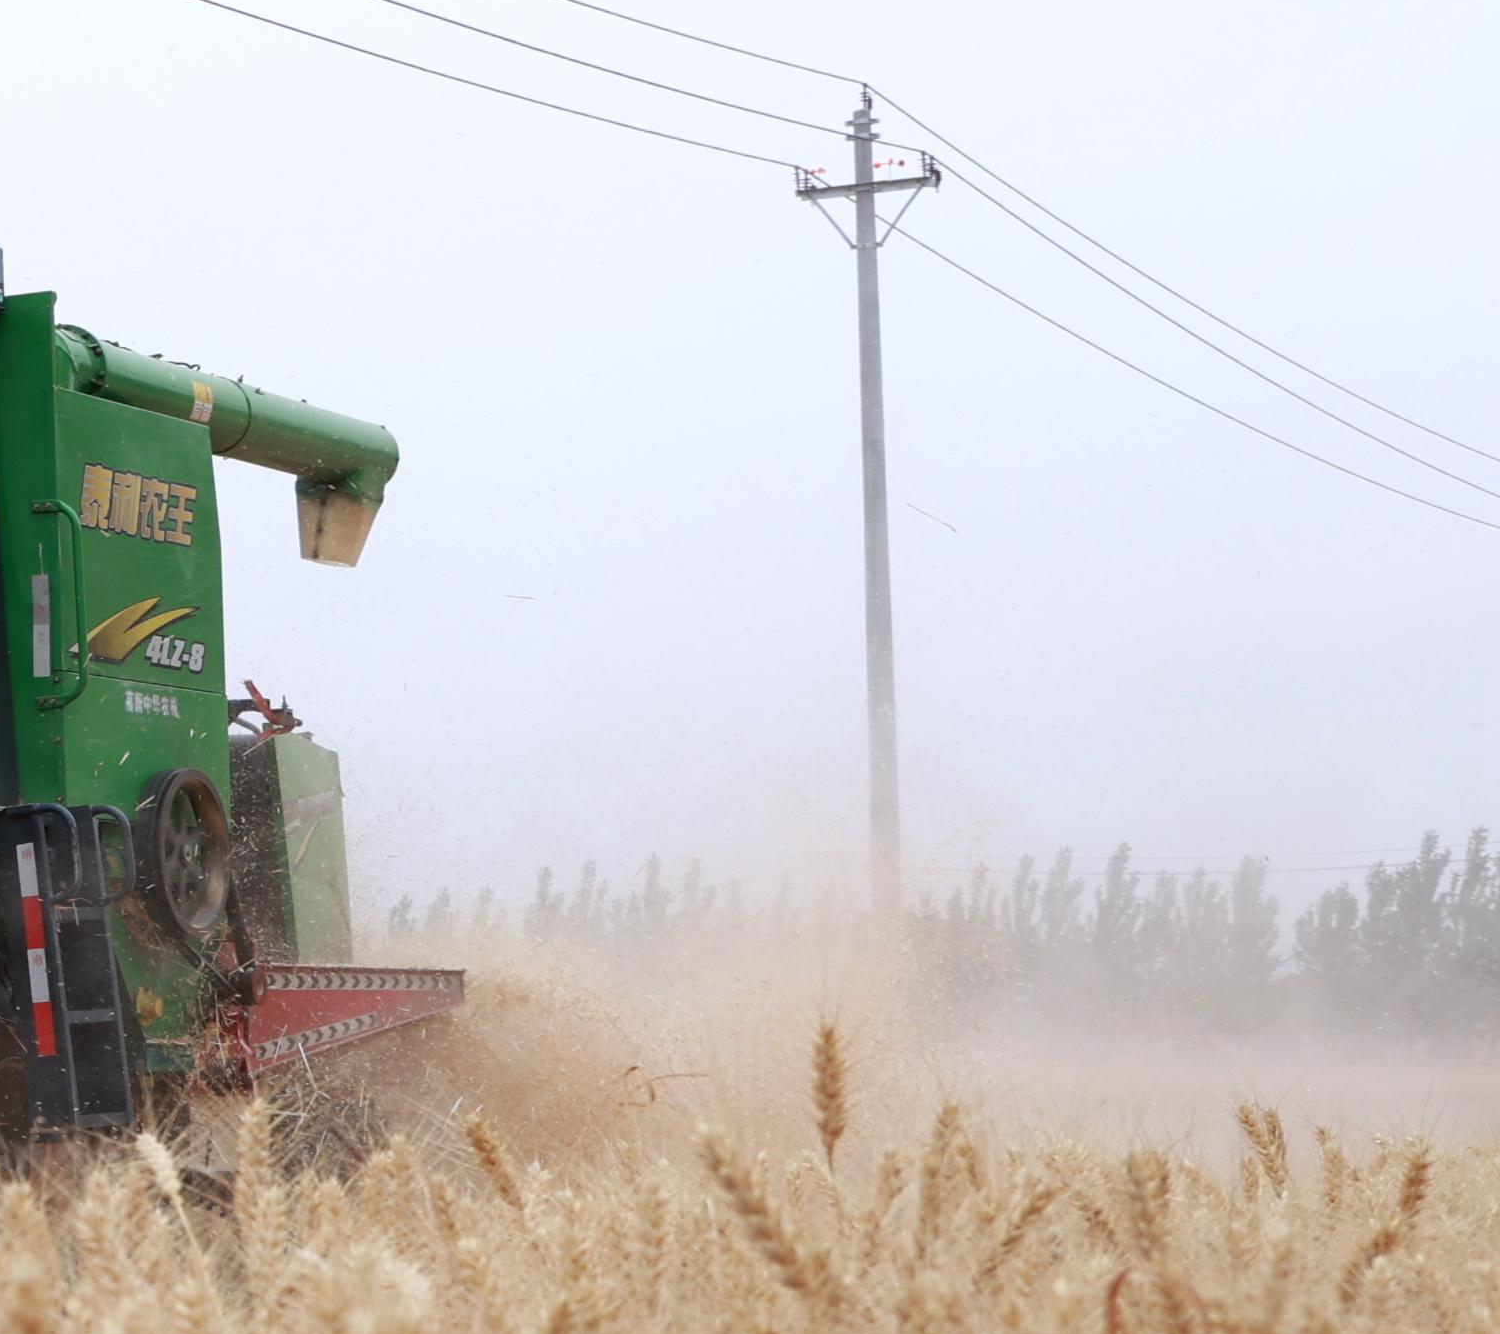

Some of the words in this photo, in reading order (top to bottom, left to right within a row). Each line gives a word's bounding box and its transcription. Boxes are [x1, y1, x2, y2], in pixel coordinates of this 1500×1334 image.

[80, 463, 197, 546] 泰利农王
[145, 634, 205, 673] 4LZ-8
